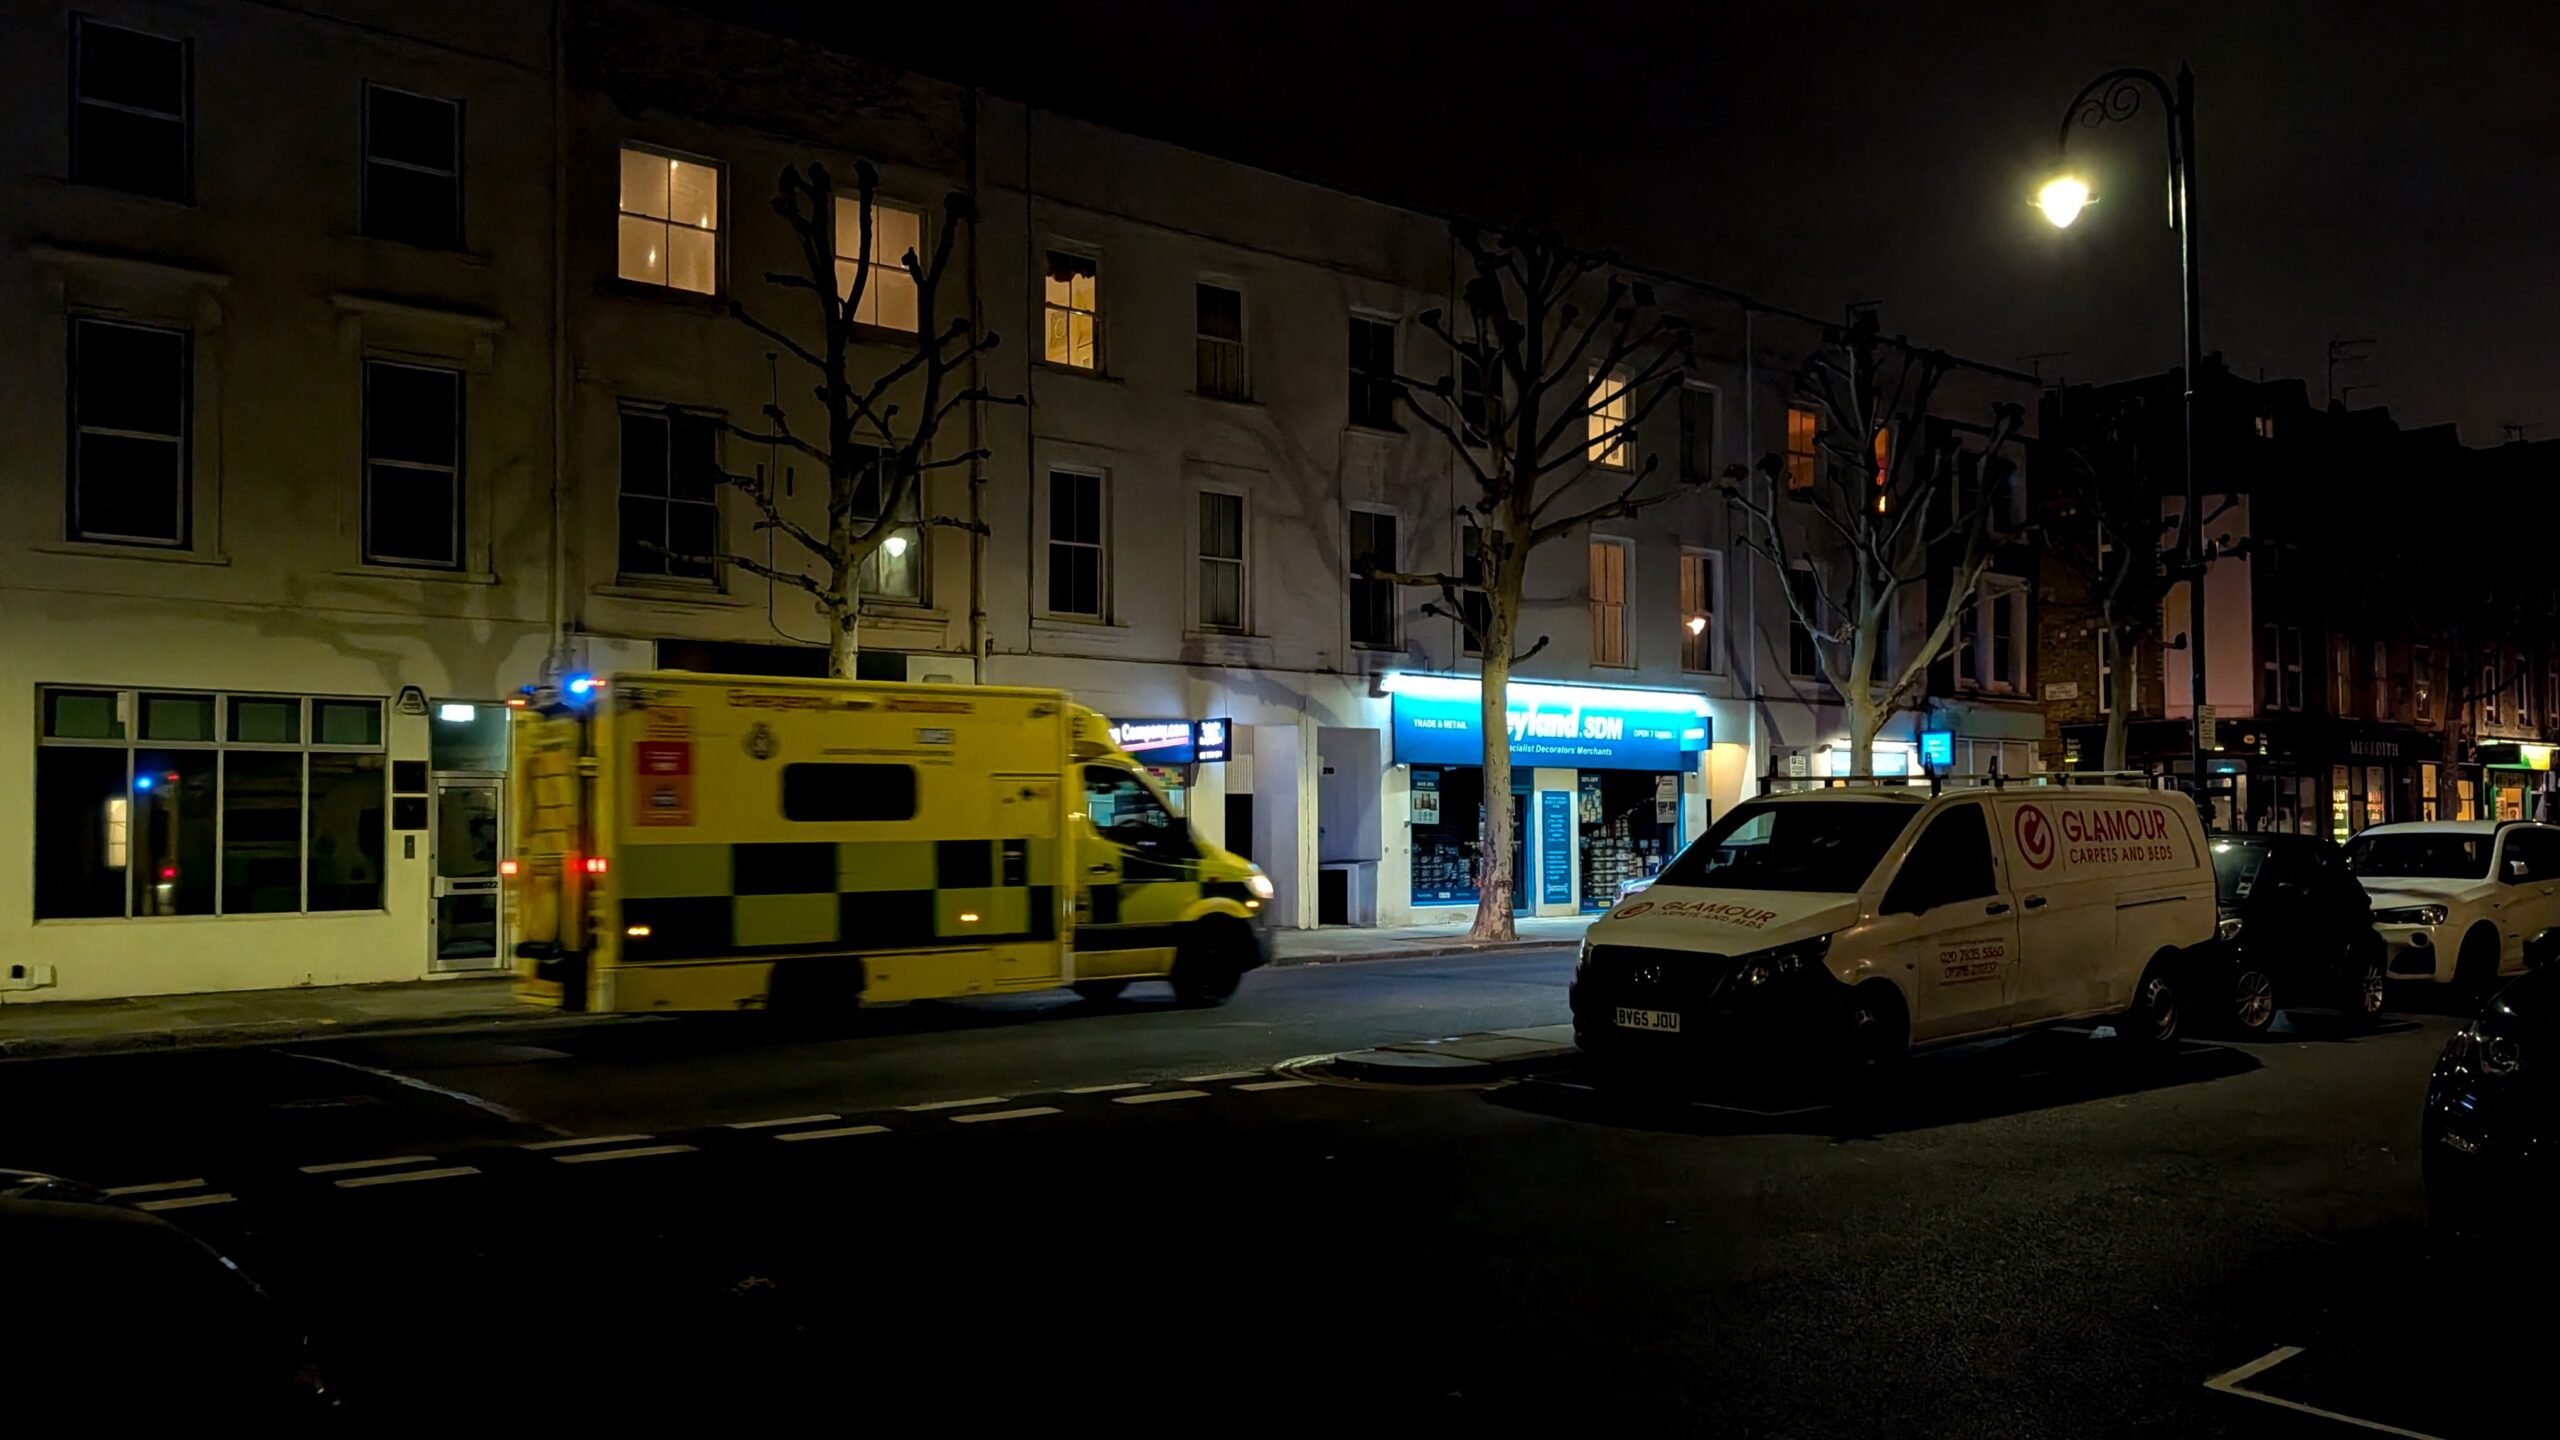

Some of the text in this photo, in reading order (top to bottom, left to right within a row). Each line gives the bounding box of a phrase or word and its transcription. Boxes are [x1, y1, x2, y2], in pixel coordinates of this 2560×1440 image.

[1413, 719, 1436, 729] TRADE
[1576, 746, 1613, 756] Merchants
[2062, 809, 2168, 842] GLAMOUR
[2070, 845, 2173, 864] CARPETS AND BEDS
[1661, 901, 1777, 923] GLAMOUR
[1618, 1009, 1649, 1026] BV65
